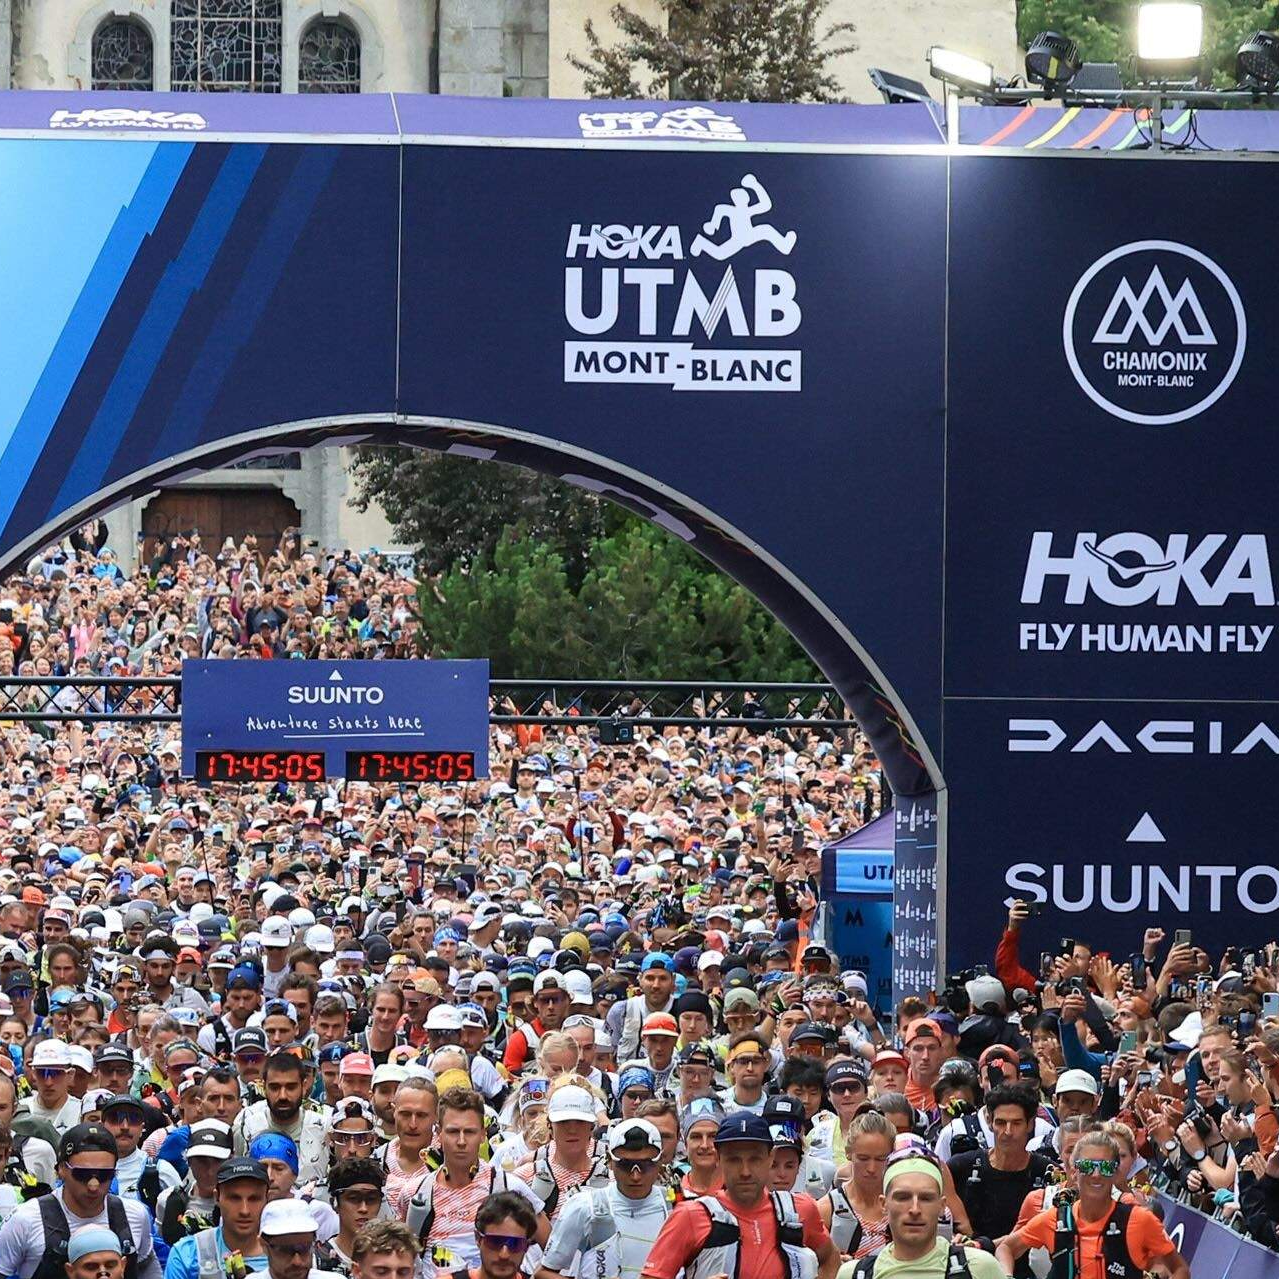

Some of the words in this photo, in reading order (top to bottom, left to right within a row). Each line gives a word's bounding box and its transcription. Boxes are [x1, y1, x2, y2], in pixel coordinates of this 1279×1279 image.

[565, 223, 684, 260] HOKA
[564, 263, 802, 341] UTMB
[1102, 351, 1208, 371] CHAMONIX
[1117, 374, 1194, 388] MONT-BLANC
[1020, 531, 1277, 607] HOKA
[1019, 622, 1076, 651] FLY
[1081, 624, 1212, 653] HUMAN
[1219, 625, 1274, 653] FLY
[287, 685, 385, 705] SUUNTO
[207, 753, 322, 781] 17:45:05
[358, 752, 473, 780] 17:45:05
[239, 1032, 260, 1041] HOKA
[232, 1165, 254, 1174] HOKA
